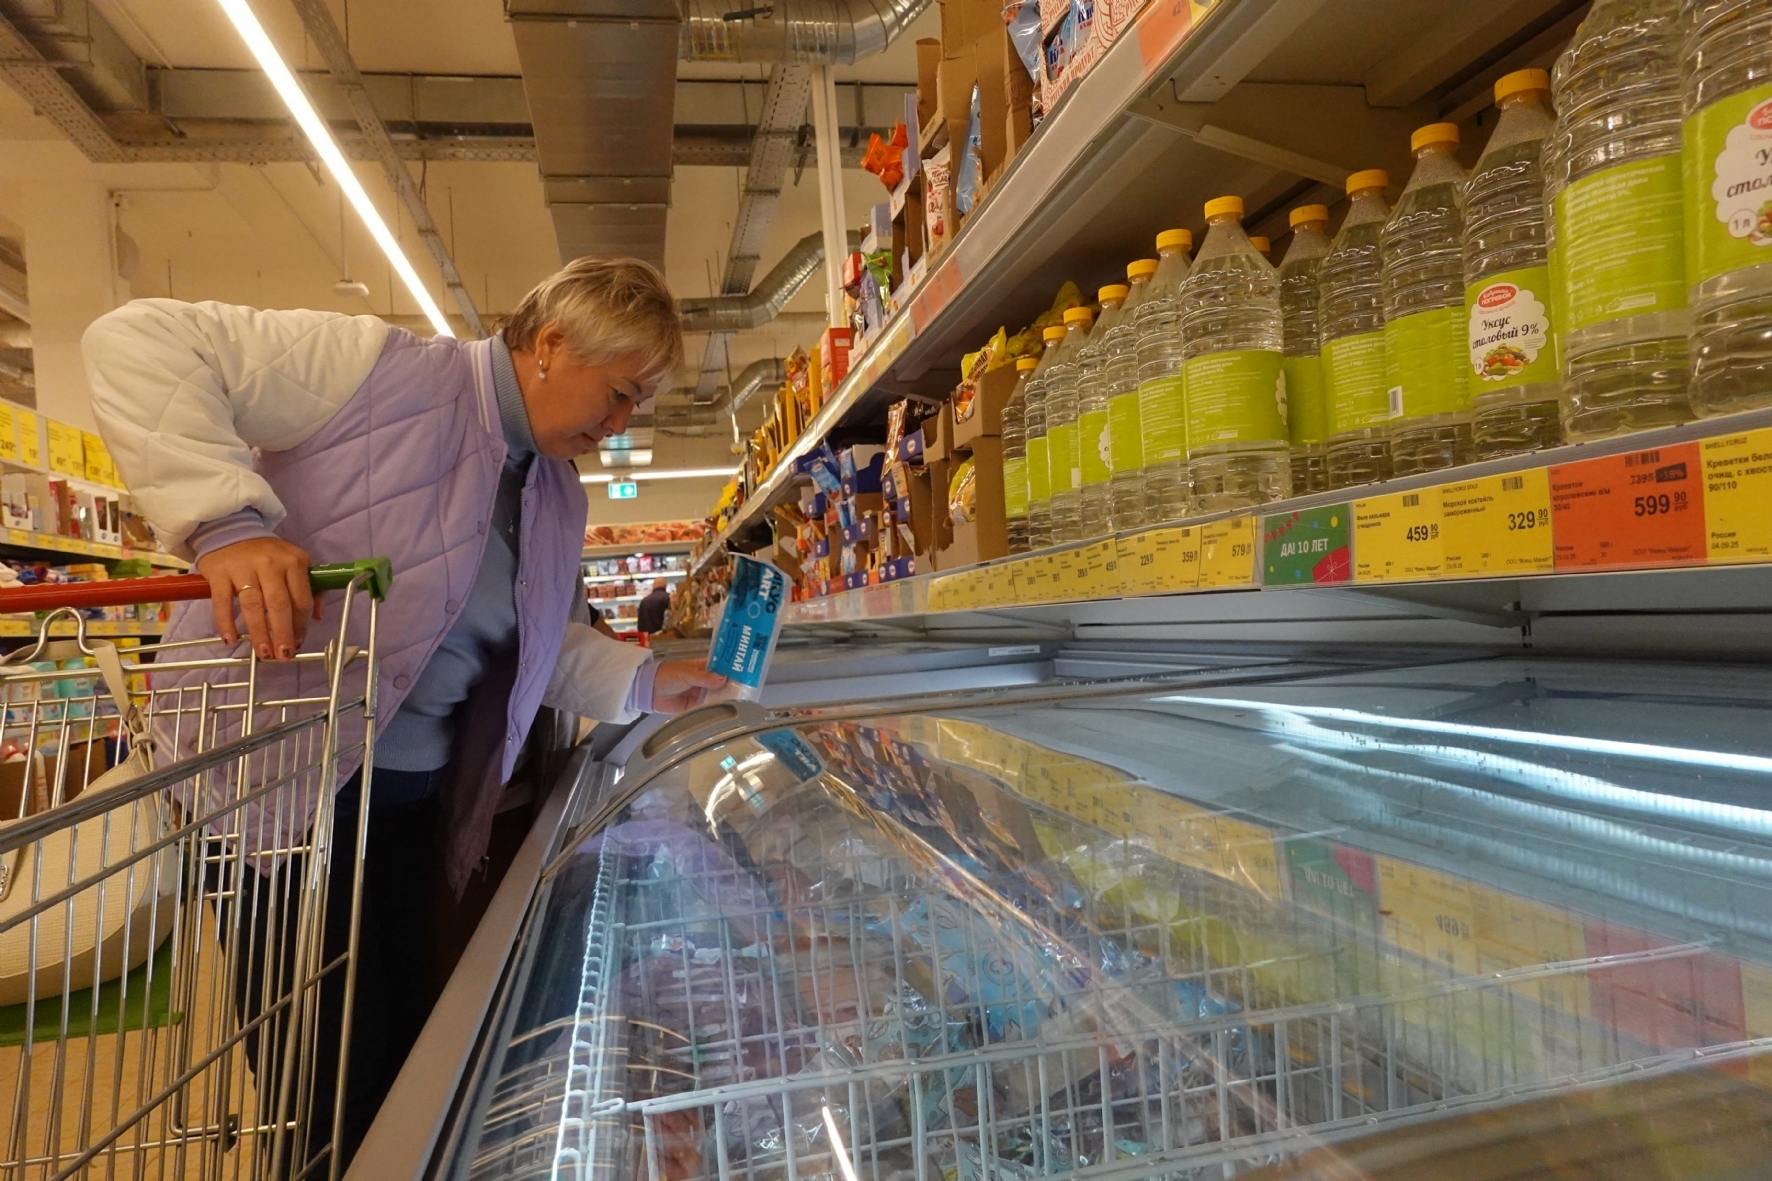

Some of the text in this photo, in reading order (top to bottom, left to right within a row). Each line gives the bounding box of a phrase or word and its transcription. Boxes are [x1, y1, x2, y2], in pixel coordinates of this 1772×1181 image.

[1481, 316, 1511, 330] Уксус
[1521, 323, 1540, 336] 9%
[1707, 456, 1749, 469] Креветки
[1708, 470, 1734, 480] очищ.
[1552, 482, 1583, 491] Креветки
[1708, 481, 1737, 492] 90/110
[1443, 496, 1494, 508] Морской коктейль
[1673, 491, 1687, 502] 90
[1634, 494, 1670, 517] 599
[1538, 508, 1548, 518] 90
[1430, 523, 1438, 531] 90
[1508, 511, 1535, 530] 329
[1407, 525, 1428, 541] 459
[1232, 544, 1245, 557] 579
[1281, 538, 1328, 557] ДА! 10 ЛЕТ
[1140, 555, 1149, 566] 229
[1182, 552, 1194, 563] 359
[759, 567, 775, 600] ART
[732, 625, 752, 672] МИНТАЙ
